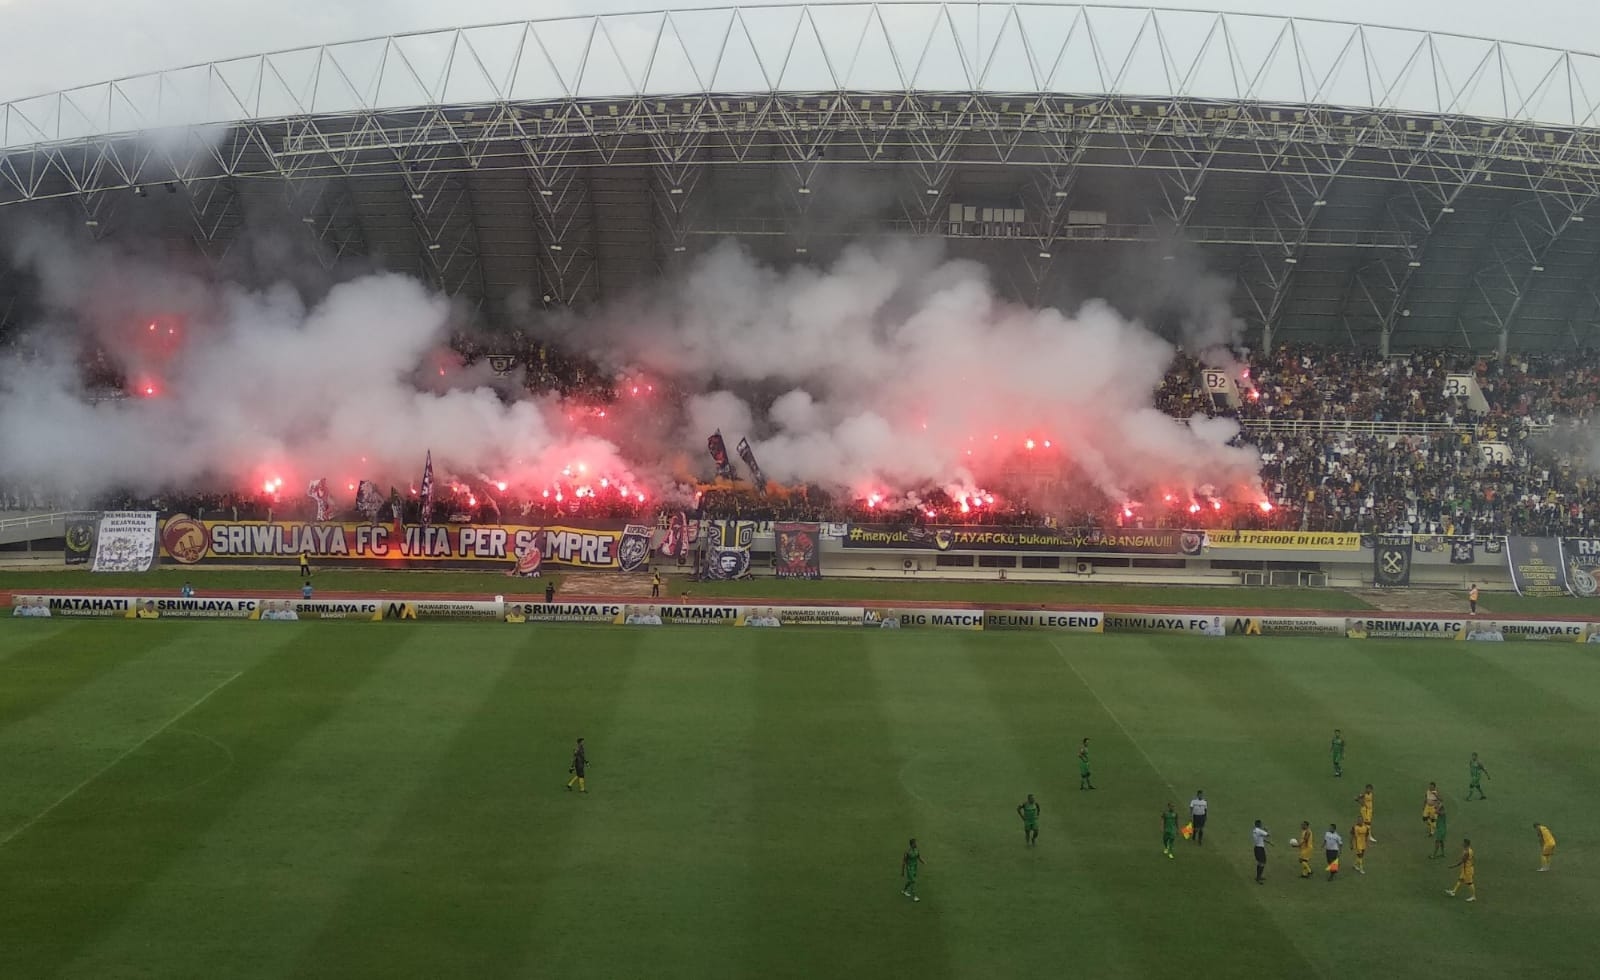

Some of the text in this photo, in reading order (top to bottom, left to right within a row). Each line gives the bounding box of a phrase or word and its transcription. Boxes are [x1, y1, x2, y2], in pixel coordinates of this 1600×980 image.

[1207, 373, 1225, 388] B2
[1447, 379, 1467, 395] B3
[211, 525, 614, 564] SRIWIJAYA FC VITA PER SMPRE
[1250, 535, 1296, 546] PERIODE
[1298, 536, 1310, 546] DI
[1311, 536, 1335, 546] LIGA
[1337, 536, 1345, 546] 2
[49, 598, 128, 611] MATAHATI
[158, 600, 256, 611] SRIWIJAYA FC
[296, 604, 376, 613] SRIWIJAYA FC
[524, 604, 620, 616] SRIWIJAYA FC
[661, 607, 738, 619] MATAHATI
[901, 614, 983, 626] BIG MATCH
[988, 615, 1099, 628] REUNI LEGEND
[1104, 617, 1209, 631] SRIWIJAYA FC
[1366, 620, 1462, 632] SRIWIJAYA FC
[1502, 625, 1581, 635] SRIWIJAYA FC
